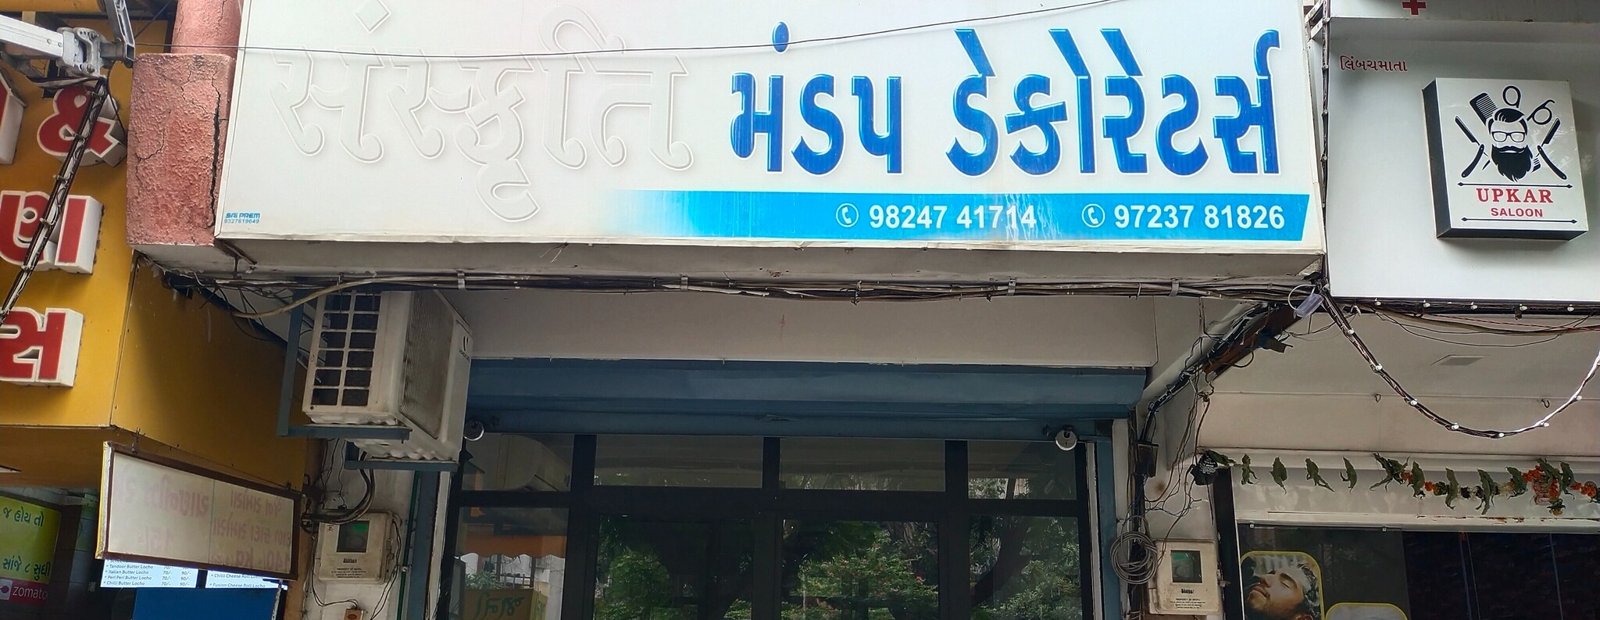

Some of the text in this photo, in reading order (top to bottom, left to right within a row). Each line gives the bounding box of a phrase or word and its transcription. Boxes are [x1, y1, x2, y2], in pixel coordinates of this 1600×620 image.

[1340, 55, 1408, 71] લિંબચમાતા
[730, 21, 1281, 176] મંડપ ડેકોરેટર્સ
[1475, 187, 1554, 203] UPKAR
[868, 206, 1036, 229] 98247 41714
[1114, 205, 1285, 229] 97237 81826
[1490, 207, 1543, 217] SALOON
[12, 586, 49, 600] zomato
